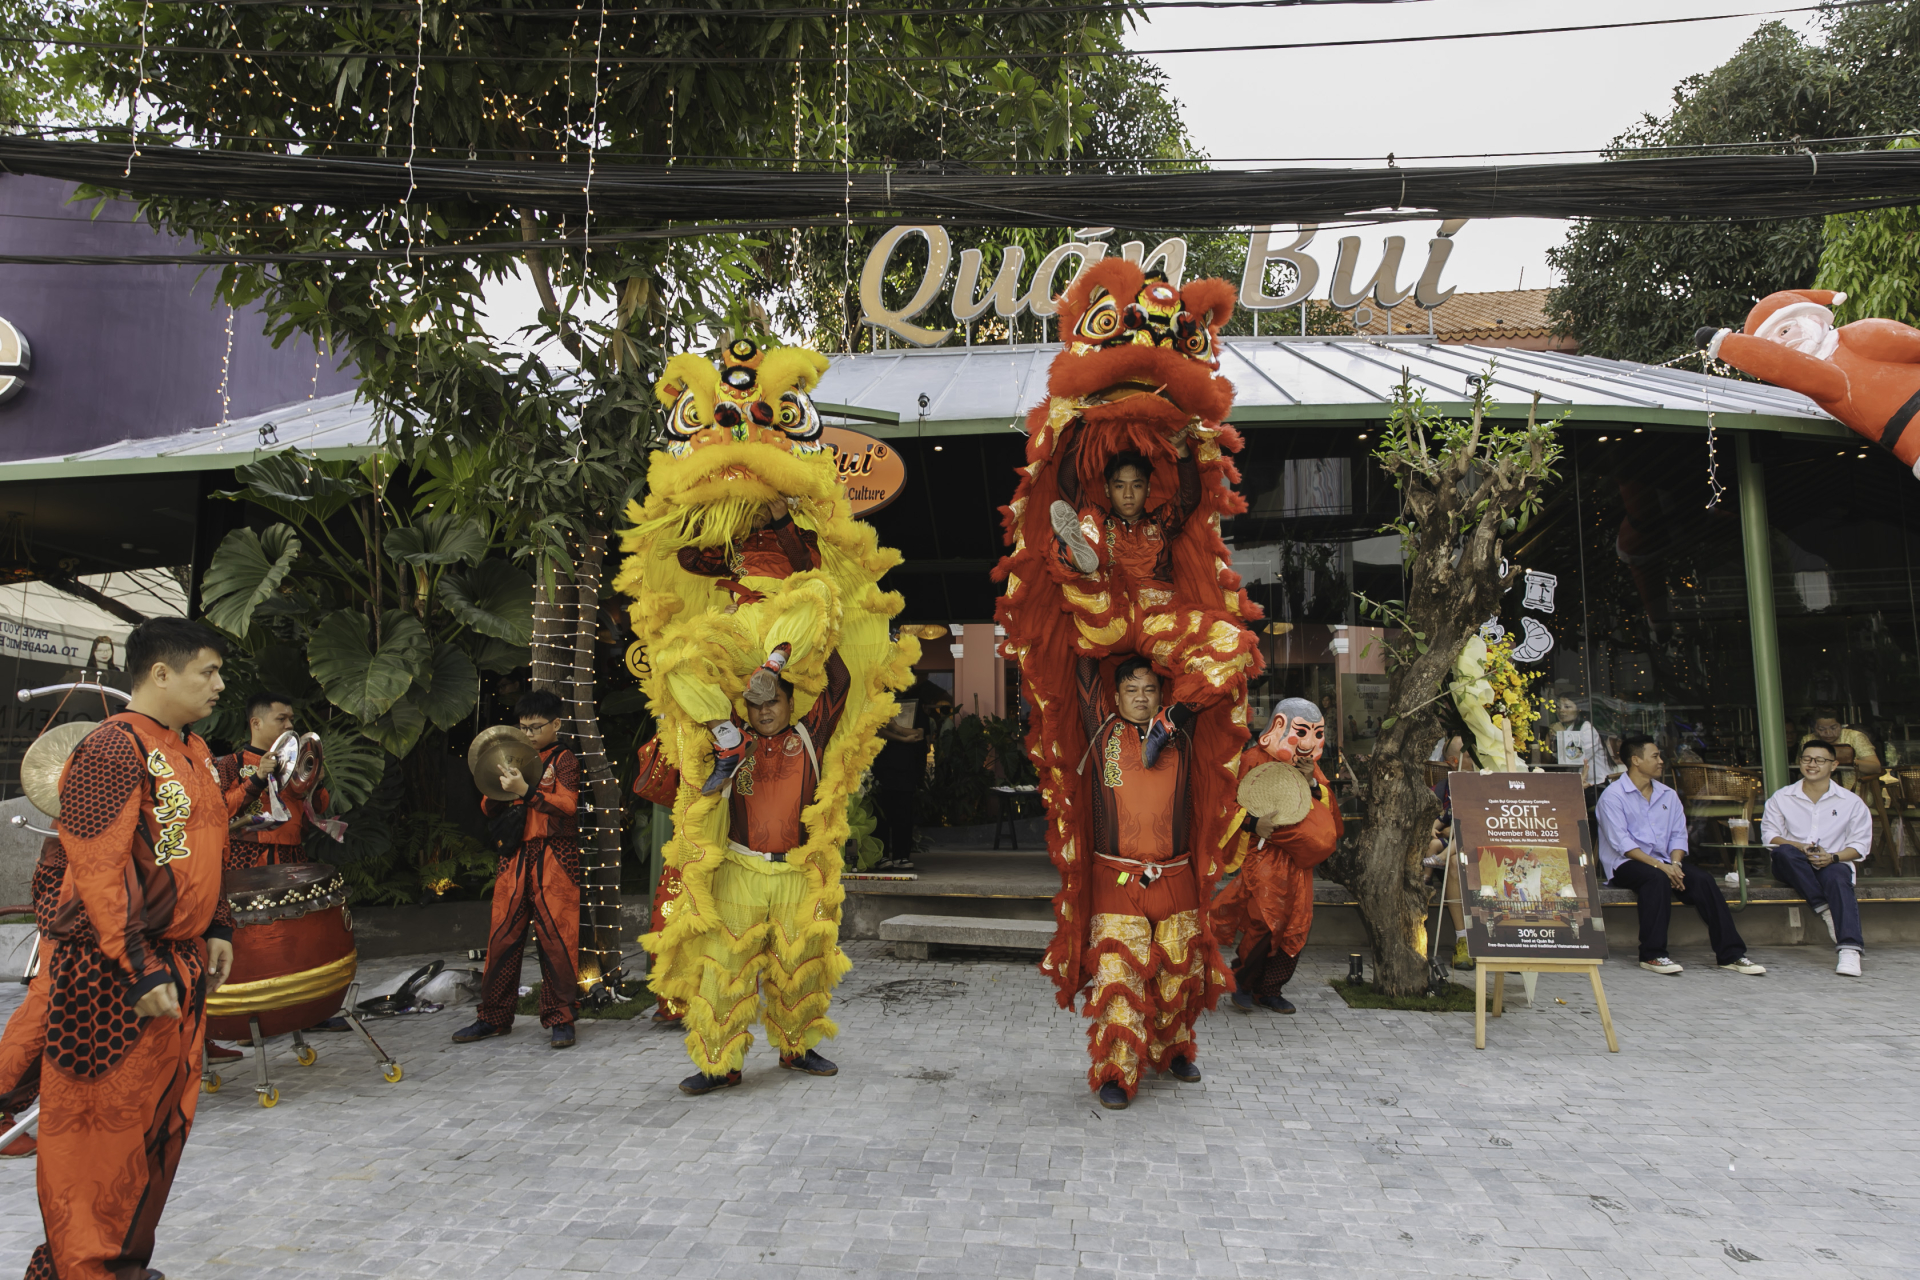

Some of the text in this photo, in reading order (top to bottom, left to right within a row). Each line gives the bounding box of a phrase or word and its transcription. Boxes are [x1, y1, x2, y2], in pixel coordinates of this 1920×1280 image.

[1500, 805, 1539, 817] SOFT
[1486, 817, 1558, 830] OPENING
[1518, 929, 1556, 938] 30% Off
